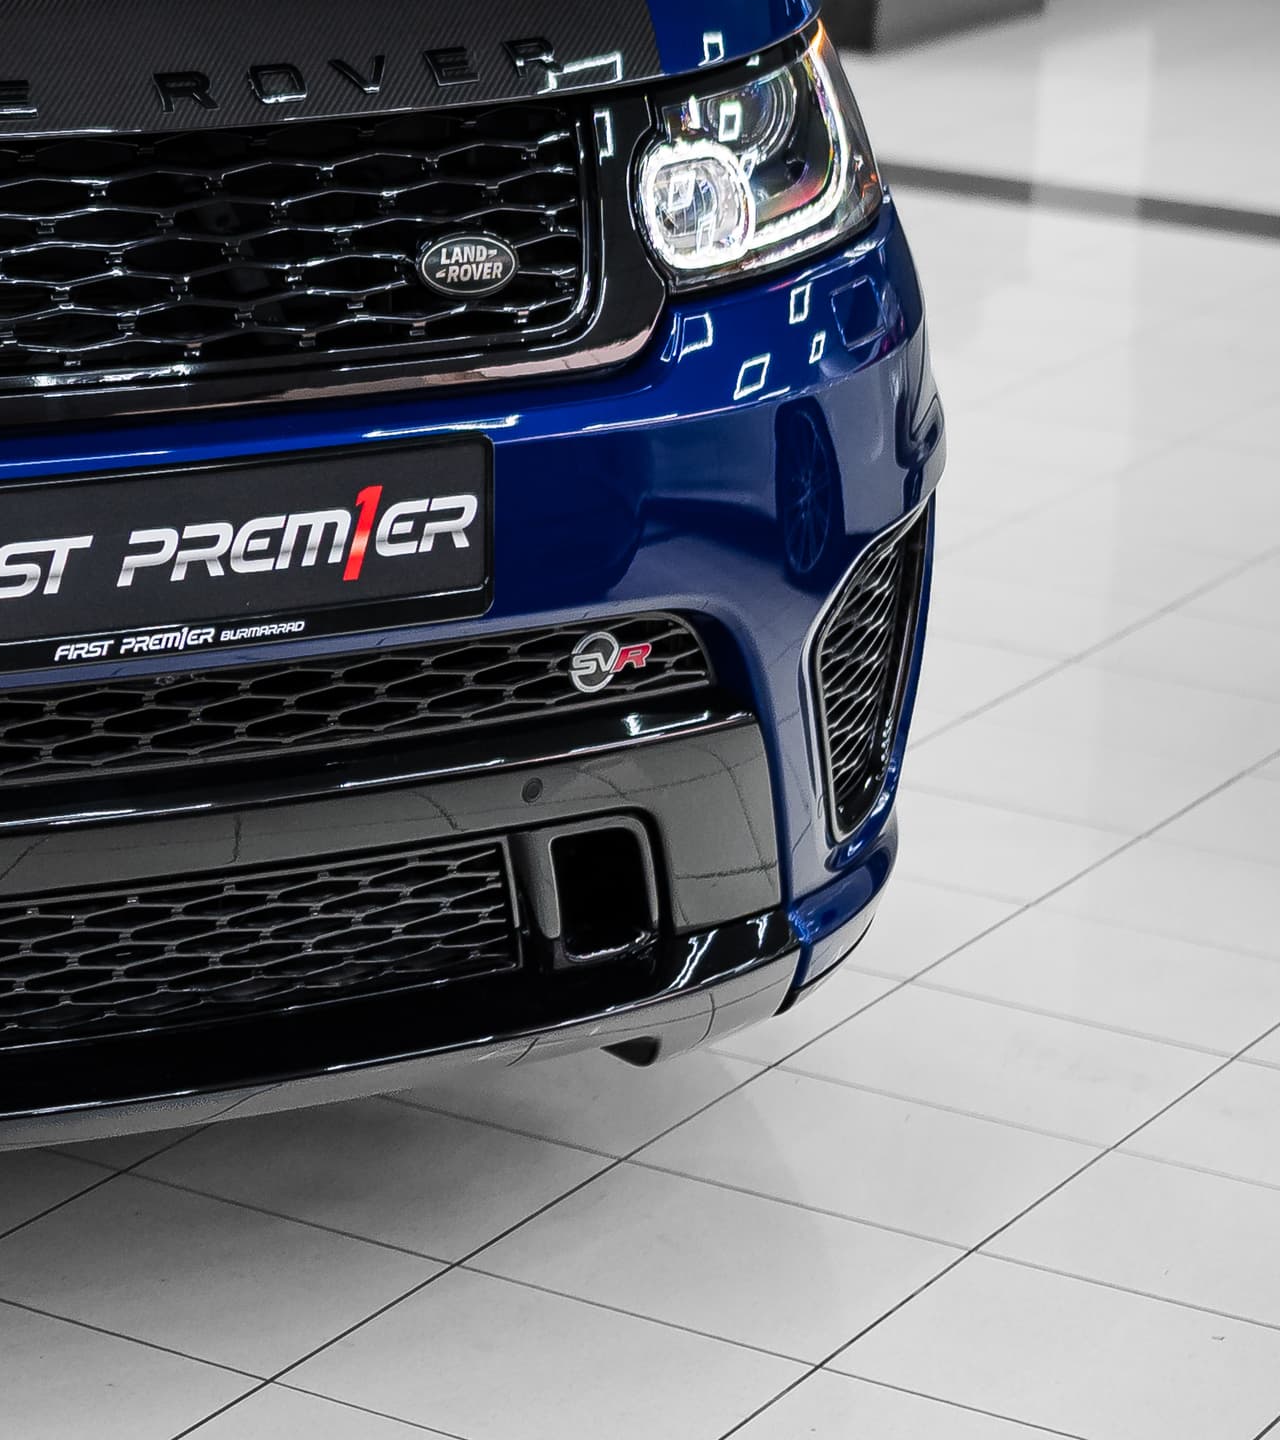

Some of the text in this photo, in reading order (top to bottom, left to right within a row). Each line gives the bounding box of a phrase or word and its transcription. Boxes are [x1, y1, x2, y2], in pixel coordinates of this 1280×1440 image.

[152, 36, 565, 113] ROVER
[440, 244, 488, 265] LAND
[446, 262, 503, 284] ROVER
[54, 639, 115, 662] FIRST
[220, 620, 305, 642] BURMARRAD
[569, 631, 653, 693] SVR
